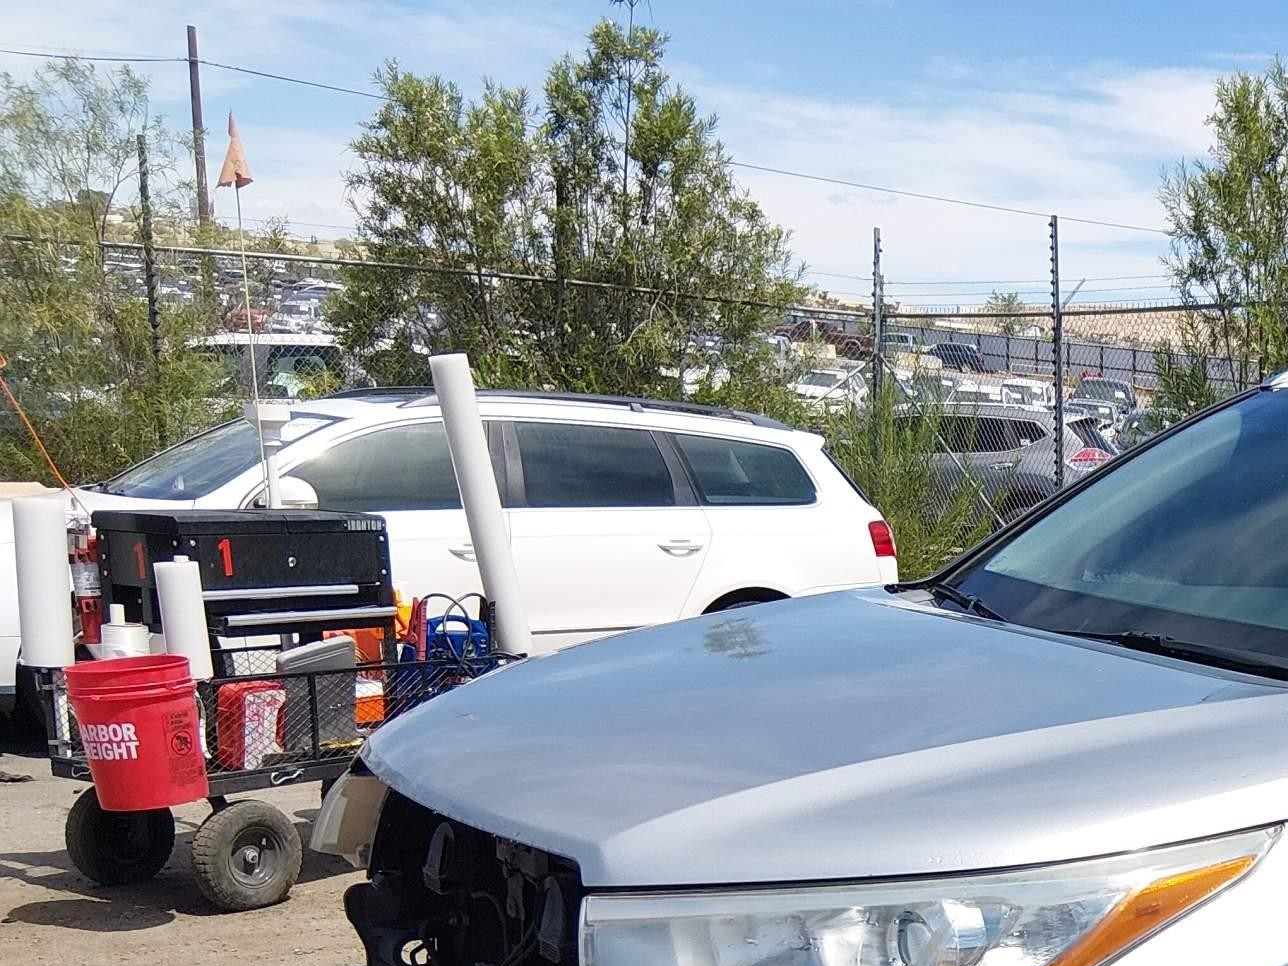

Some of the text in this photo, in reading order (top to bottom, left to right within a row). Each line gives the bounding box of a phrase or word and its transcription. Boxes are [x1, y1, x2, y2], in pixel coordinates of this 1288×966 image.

[132, 542, 147, 580] 1
[217, 537, 234, 577] 1
[80, 722, 139, 743] ARBOR
[84, 740, 140, 761] REIGHT
